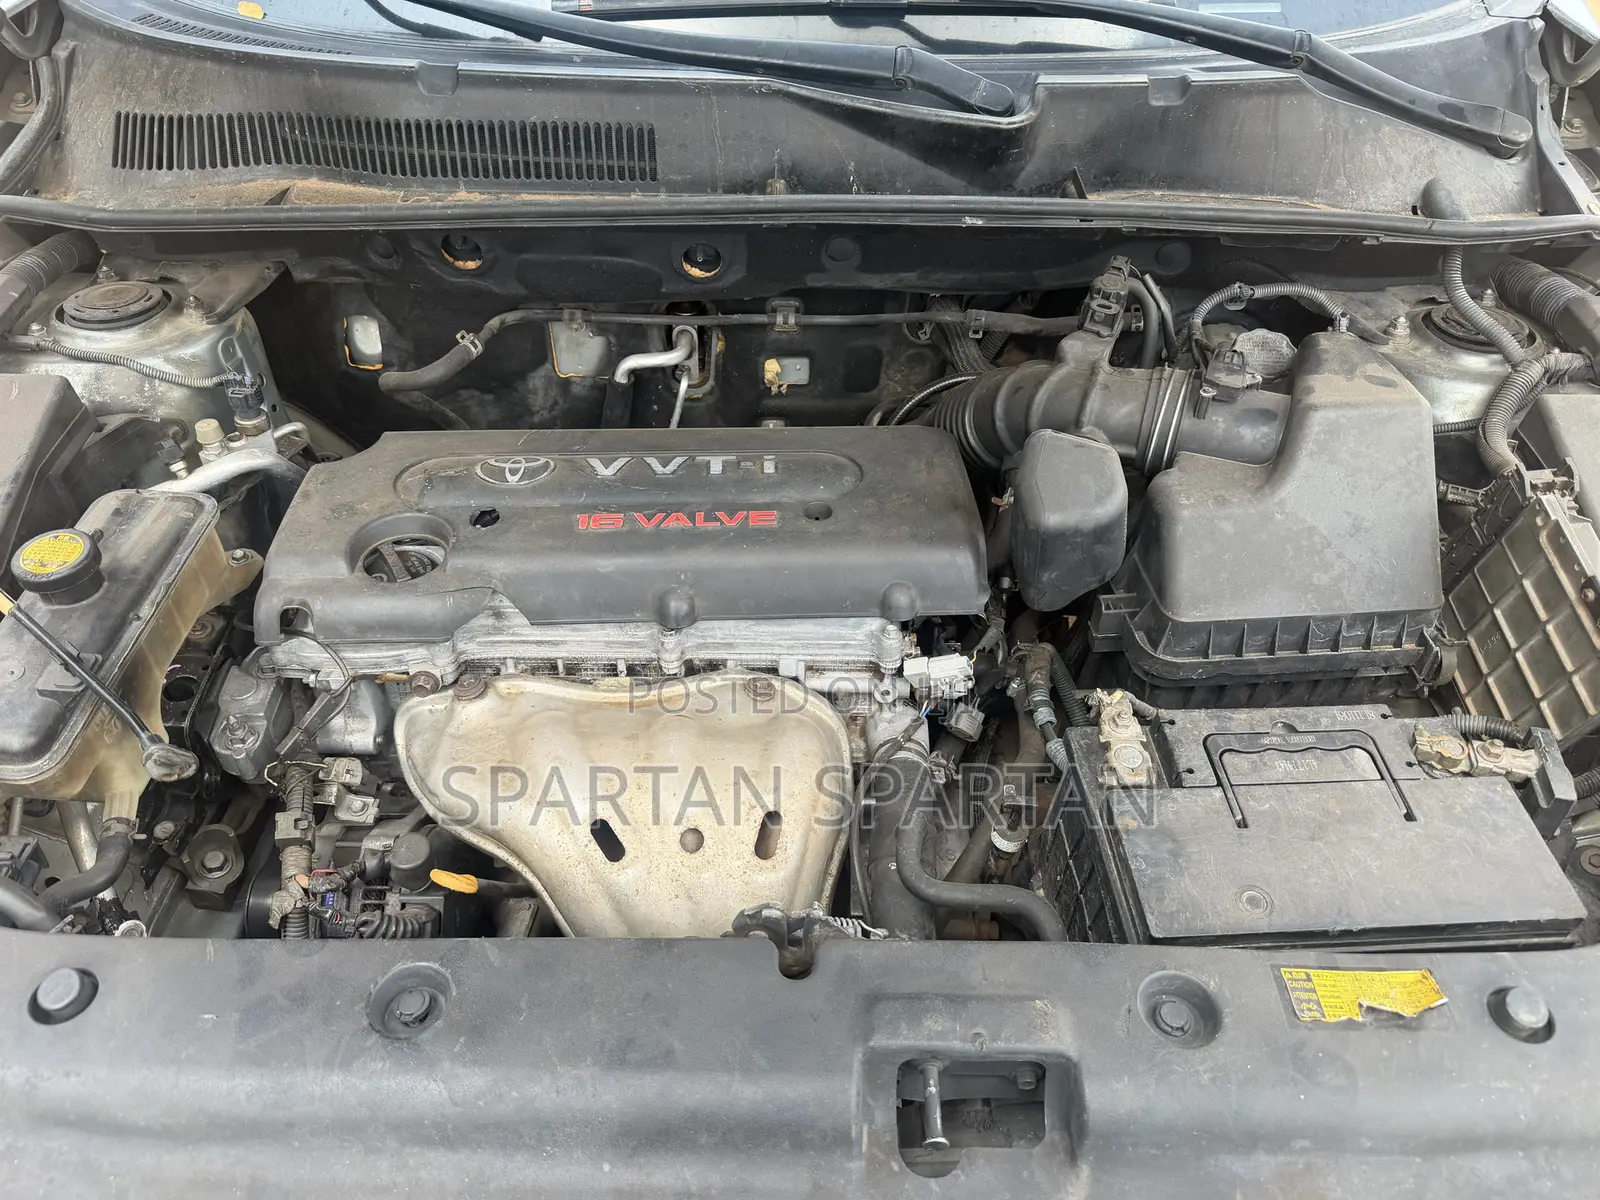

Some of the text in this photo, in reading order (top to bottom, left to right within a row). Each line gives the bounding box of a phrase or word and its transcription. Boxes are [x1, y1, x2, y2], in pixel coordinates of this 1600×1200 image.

[583, 454, 780, 477] VVT-i
[576, 509, 779, 531] 16 VALVE
[1288, 980, 1314, 989] CAUTION
